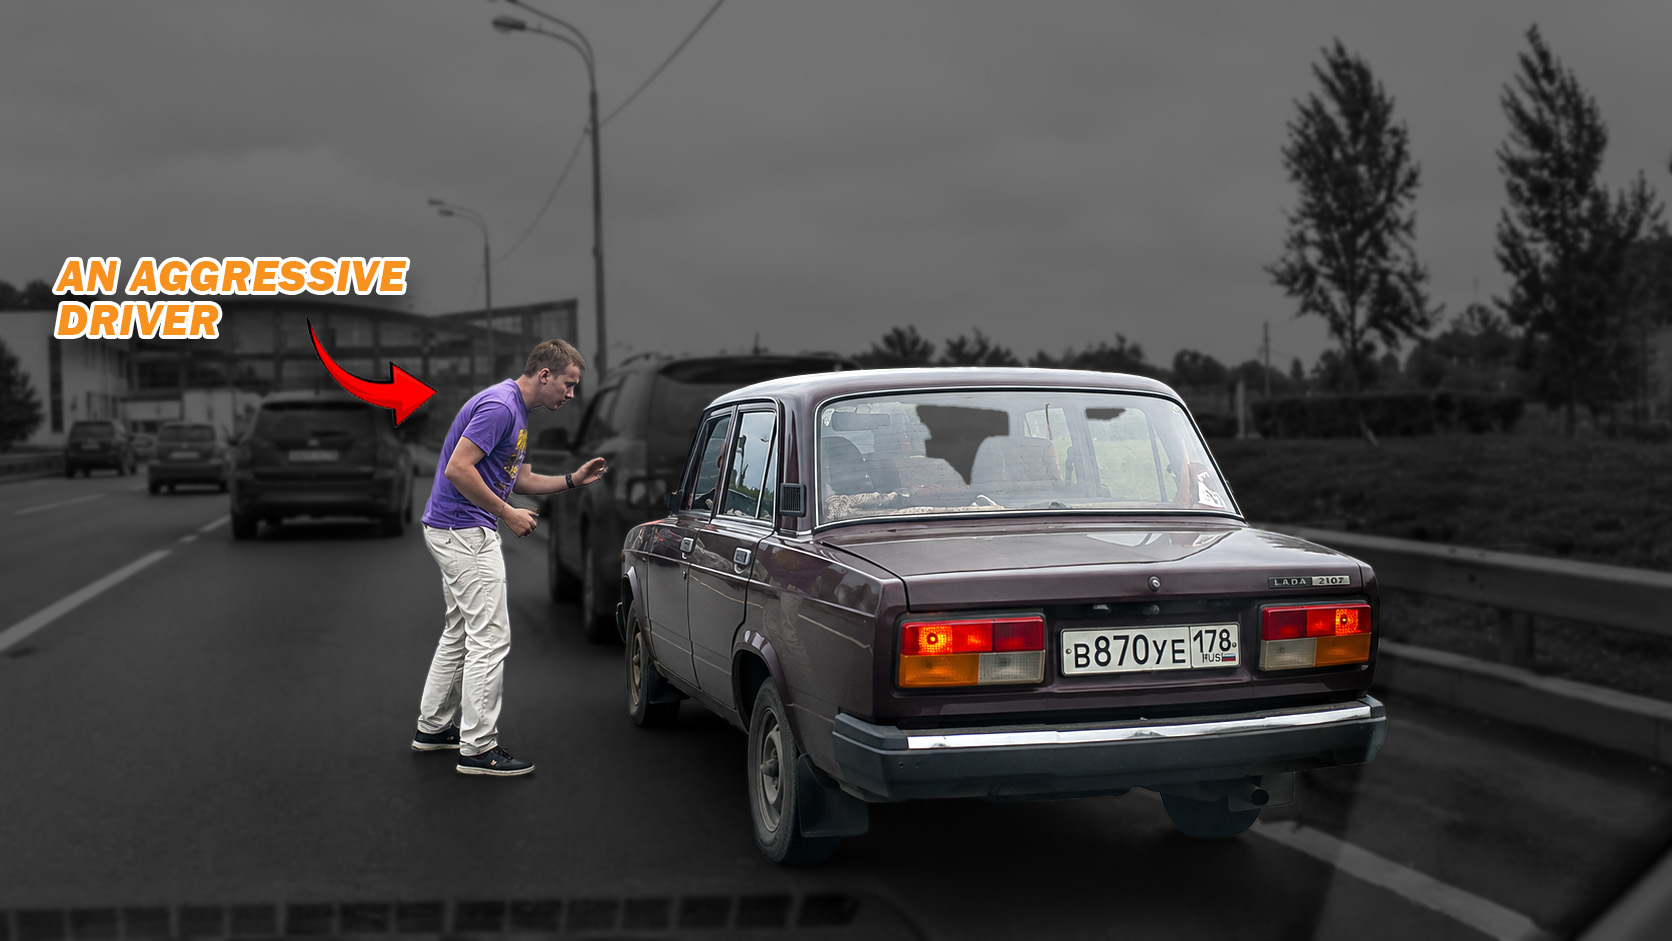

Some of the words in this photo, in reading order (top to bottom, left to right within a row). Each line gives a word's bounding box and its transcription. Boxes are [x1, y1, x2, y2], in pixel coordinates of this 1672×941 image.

[1273, 577, 1307, 587] LADA
[1318, 576, 1344, 585] 2107
[1192, 628, 1232, 653] 178
